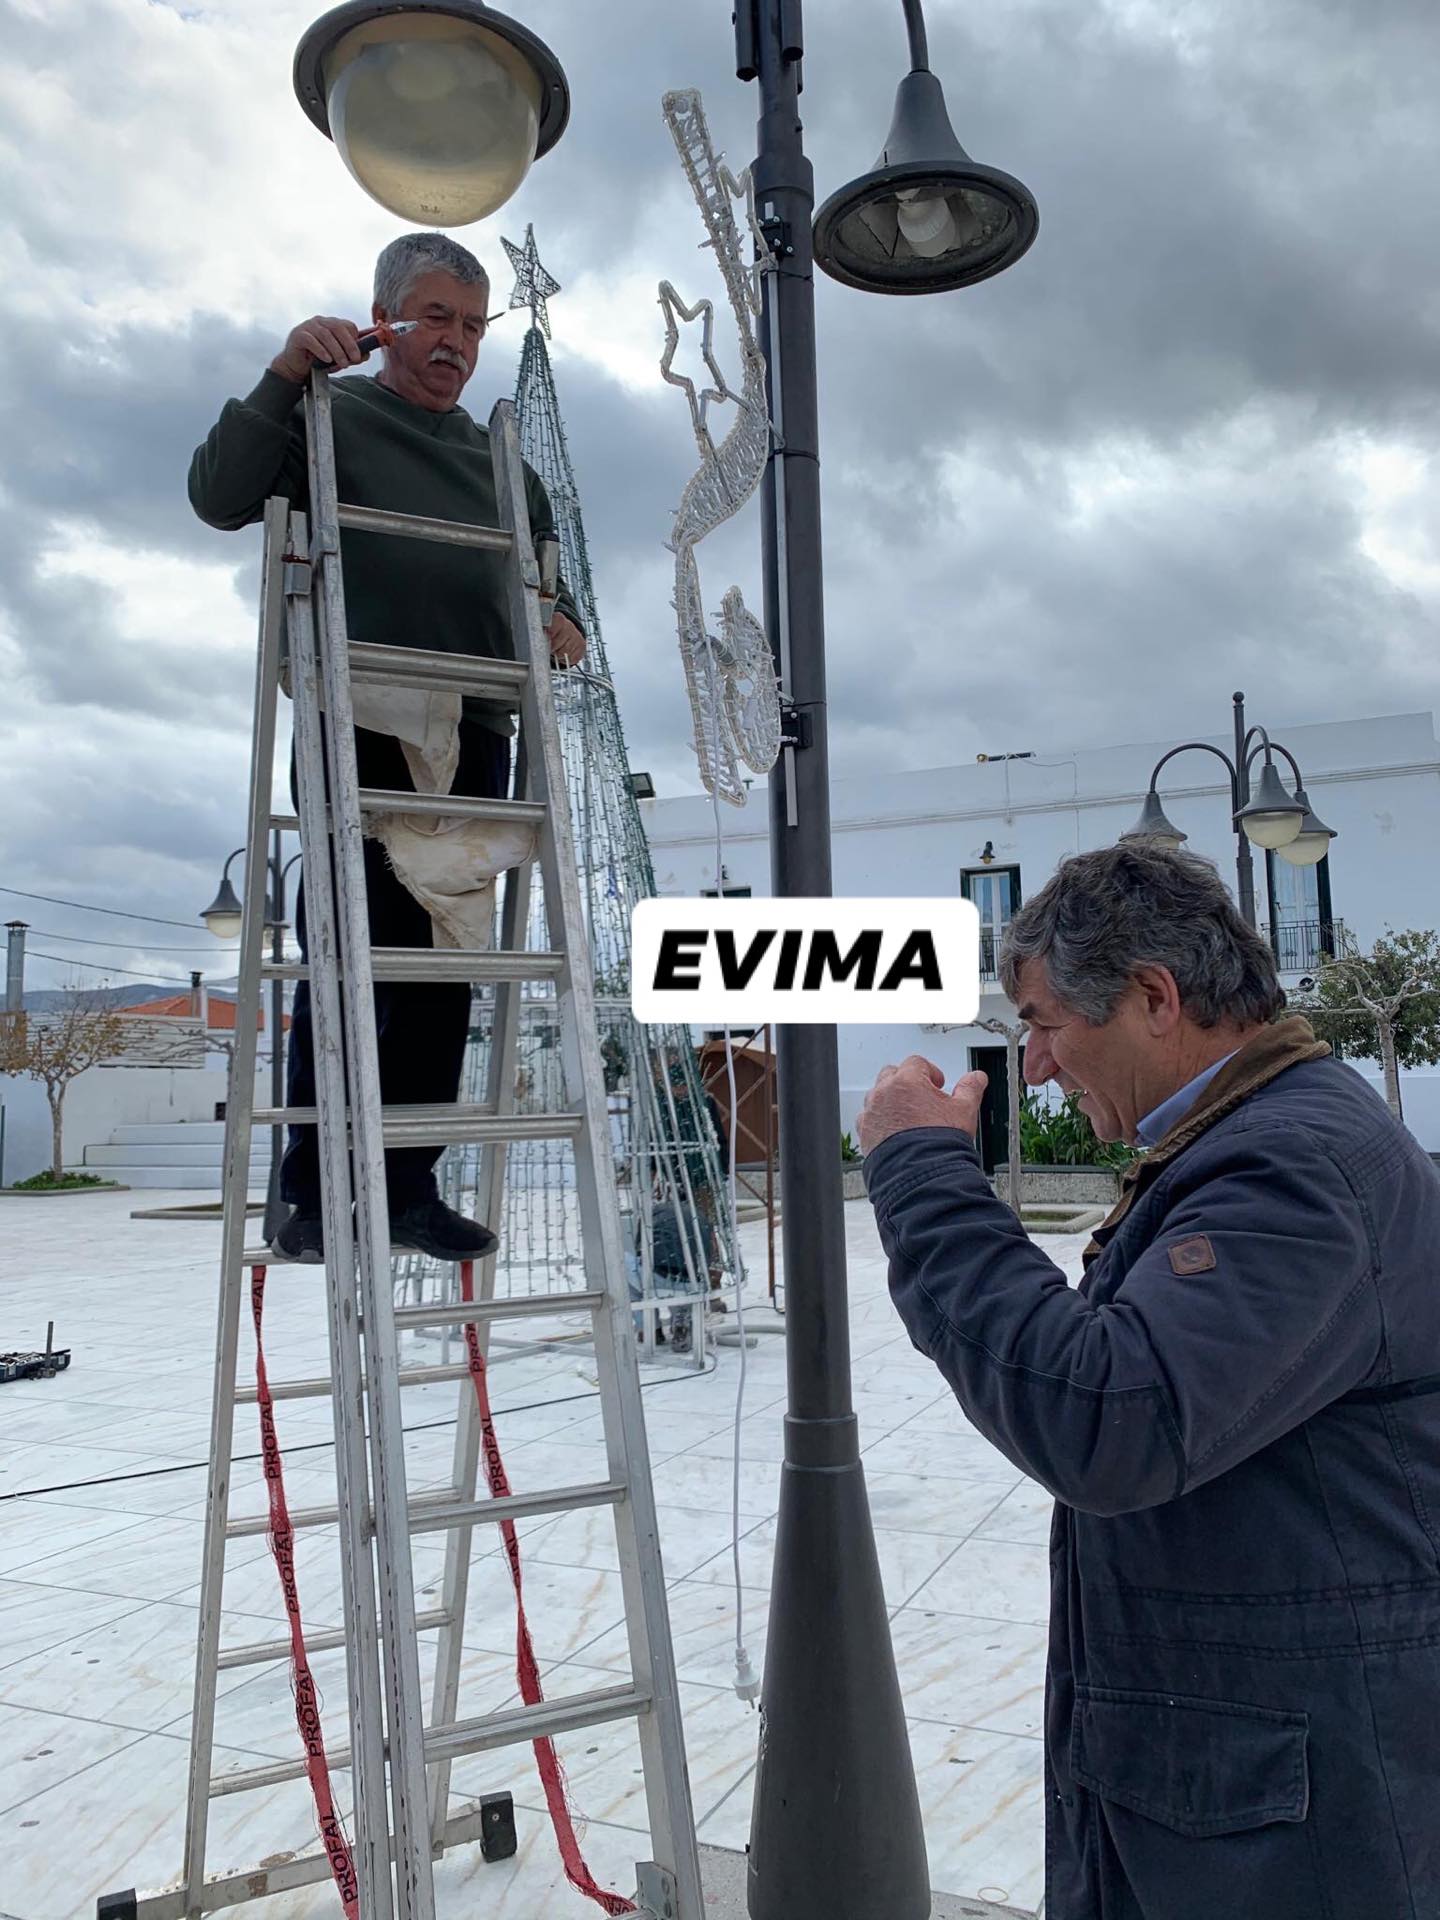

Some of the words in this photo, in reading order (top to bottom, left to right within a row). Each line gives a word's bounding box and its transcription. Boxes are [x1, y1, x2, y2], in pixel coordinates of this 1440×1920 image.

[261, 1395, 281, 1479] PROFAL
[482, 1411, 508, 1491] PROFAL
[322, 1807, 358, 1903] PROFAL
